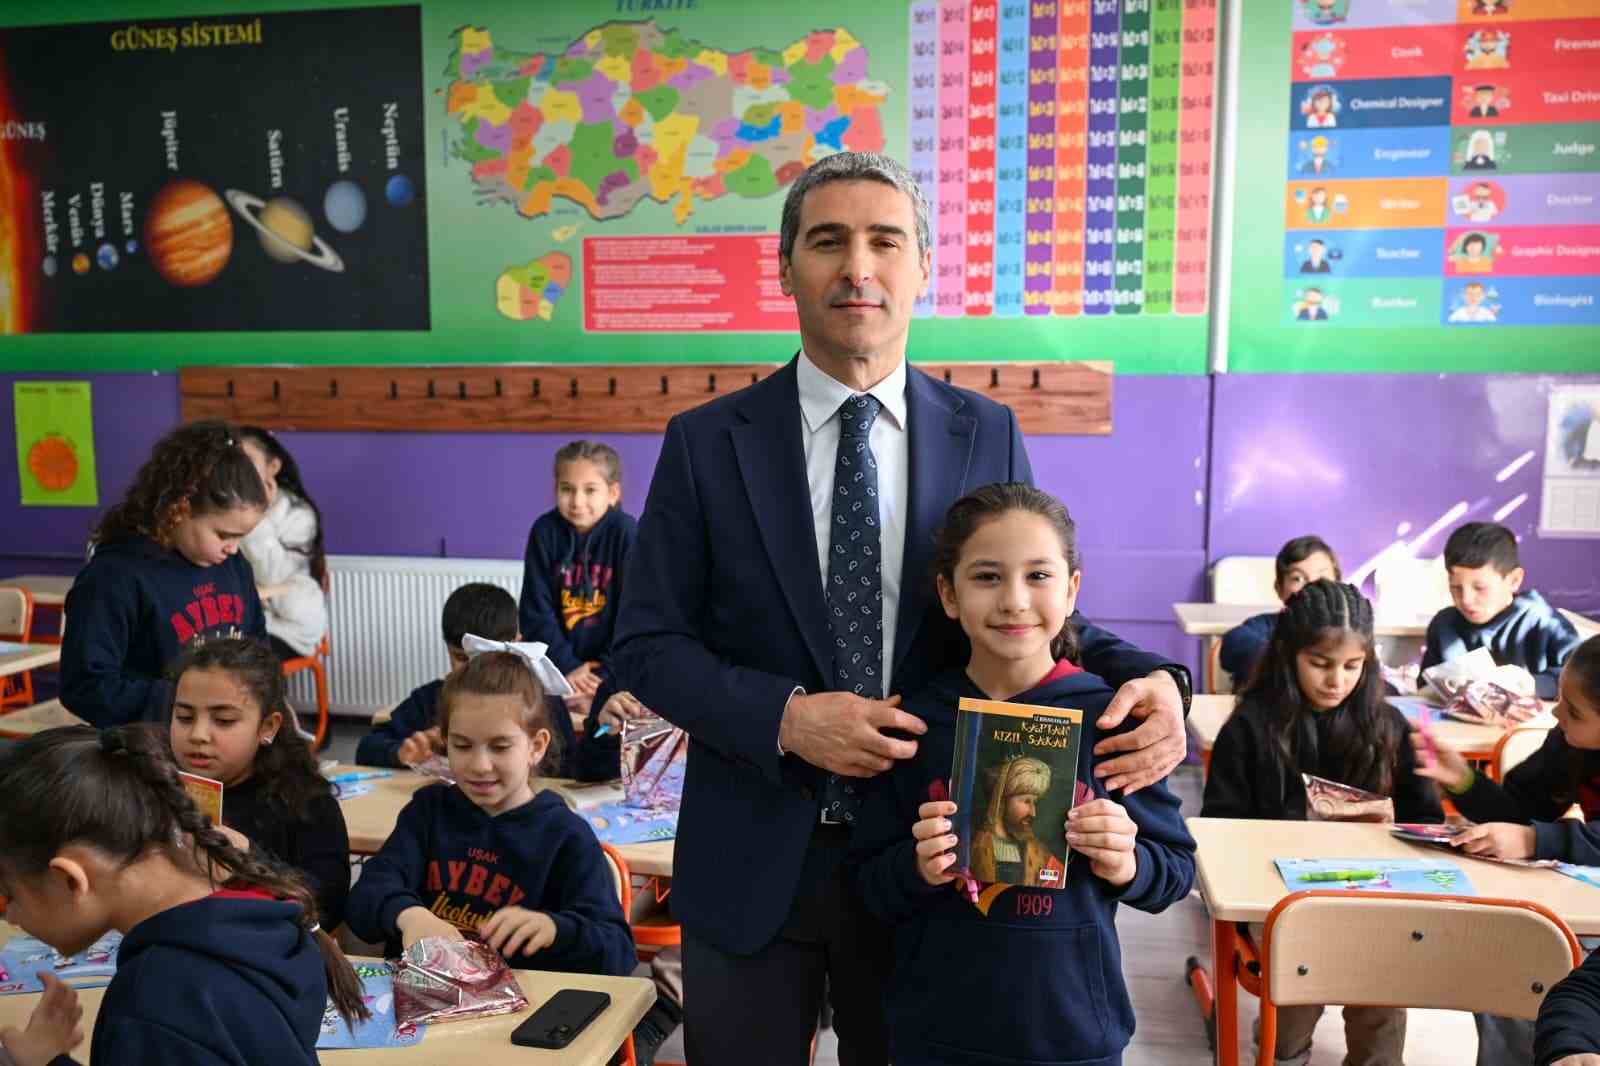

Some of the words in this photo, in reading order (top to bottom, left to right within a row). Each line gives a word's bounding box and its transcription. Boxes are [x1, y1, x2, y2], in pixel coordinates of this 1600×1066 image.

[111, 26, 177, 52] GÜNEŞ
[180, 17, 262, 46] SİSTEMİ
[160, 110, 179, 171] Jüpiter
[267, 129, 284, 189] Satürn
[333, 107, 352, 172] Uranüs
[381, 103, 401, 170] Neptün
[67, 193, 84, 247] Venüs
[89, 182, 105, 238] Dünya
[119, 191, 134, 235] Mars
[1016, 894, 1053, 916] 1909
